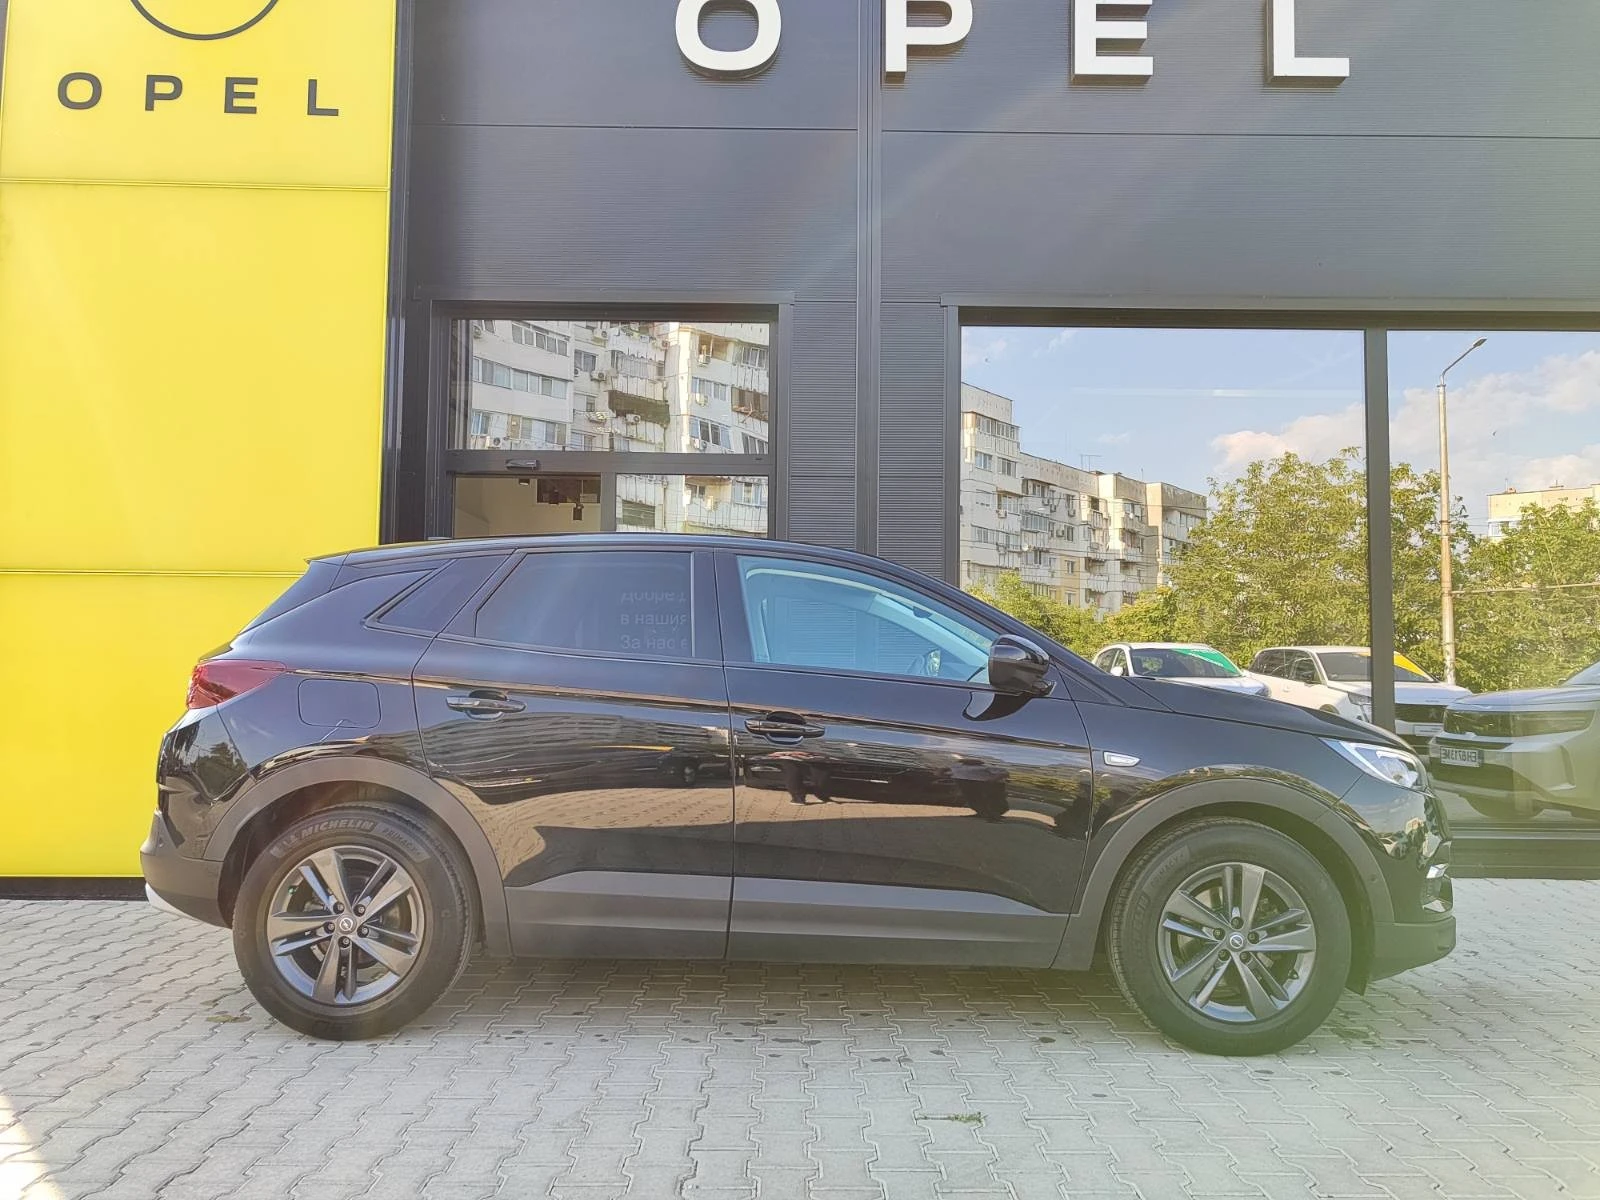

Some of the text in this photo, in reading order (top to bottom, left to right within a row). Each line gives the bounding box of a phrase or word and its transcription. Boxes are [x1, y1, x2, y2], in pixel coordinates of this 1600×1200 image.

[675, 0, 1350, 80] OPEL
[57, 71, 340, 117] OPEL
[620, 634, 641, 649] За
[301, 818, 375, 839] MICHELIN
